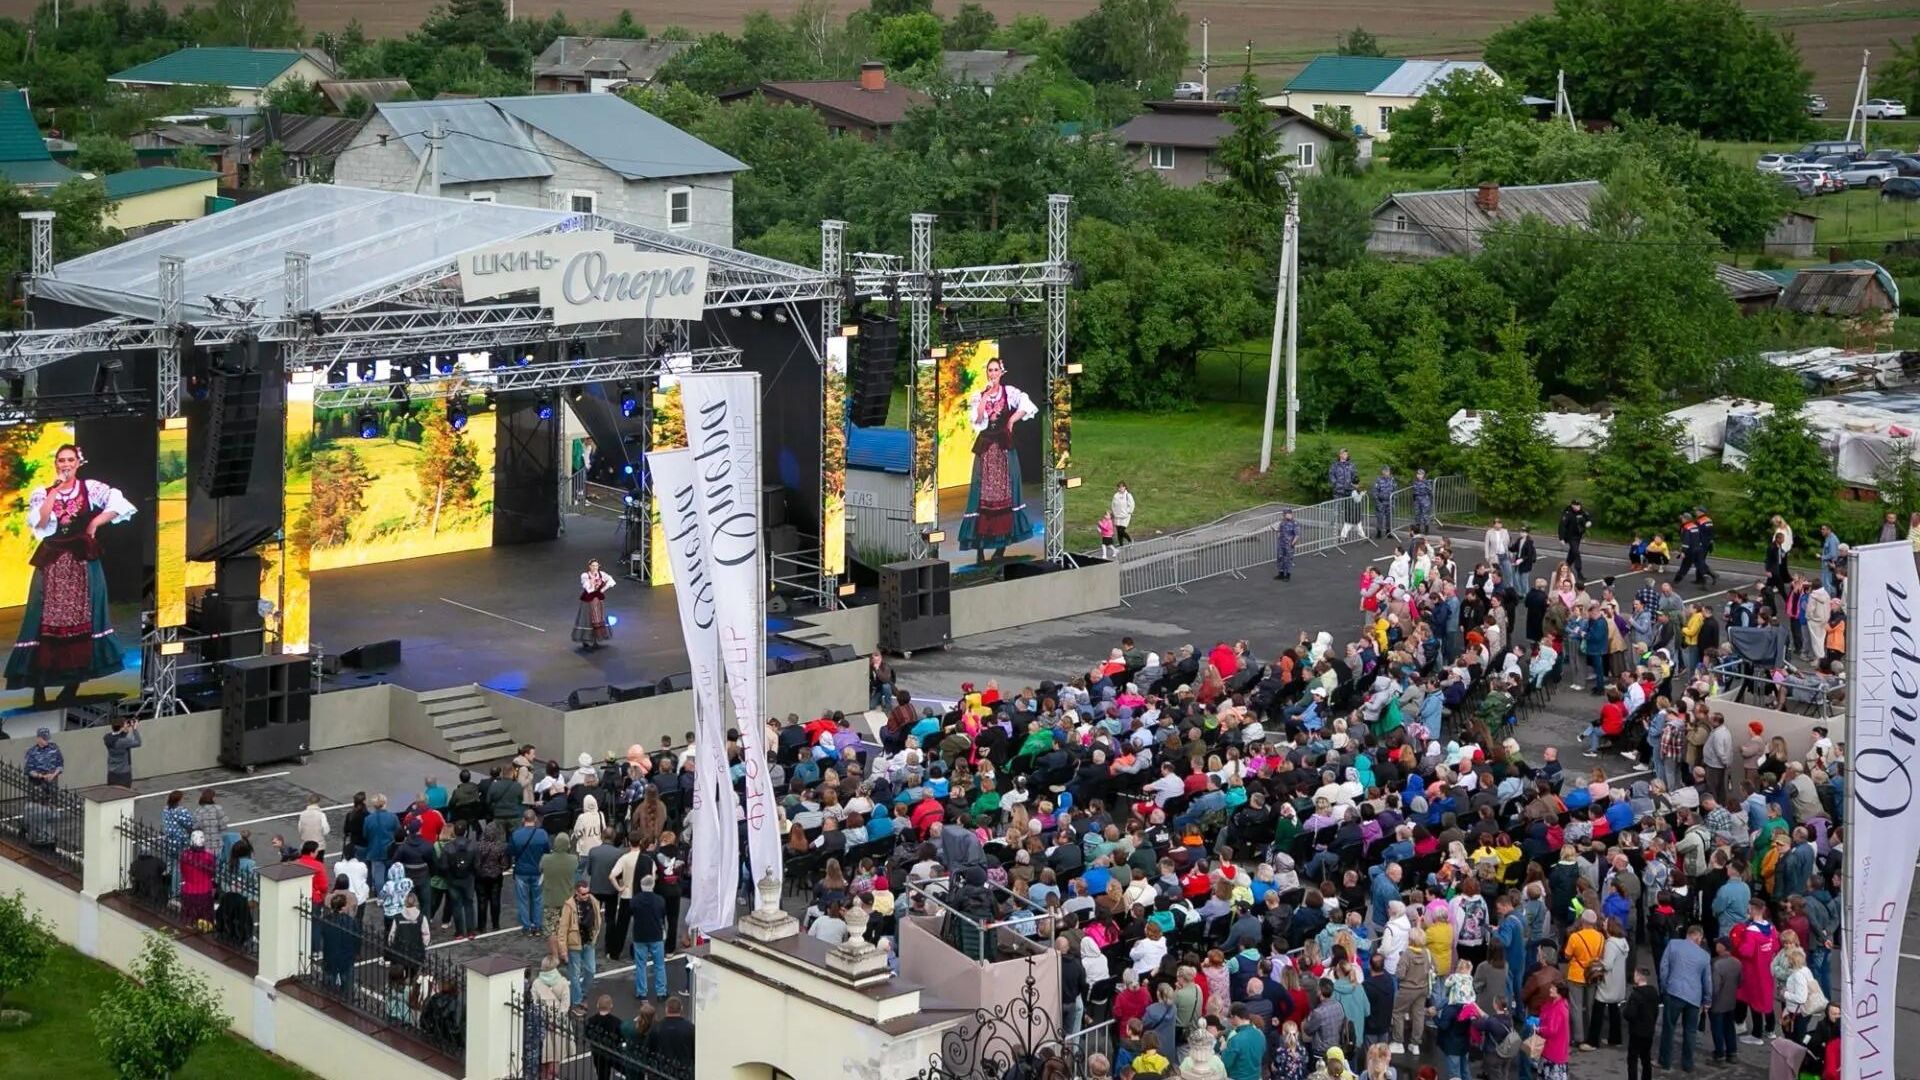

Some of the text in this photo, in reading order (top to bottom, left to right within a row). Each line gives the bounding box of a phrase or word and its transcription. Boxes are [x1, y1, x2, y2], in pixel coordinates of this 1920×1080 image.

[562, 251, 696, 318] Опера
[853, 491, 872, 506] ГАЗ
[1854, 580, 1920, 819] Опера
